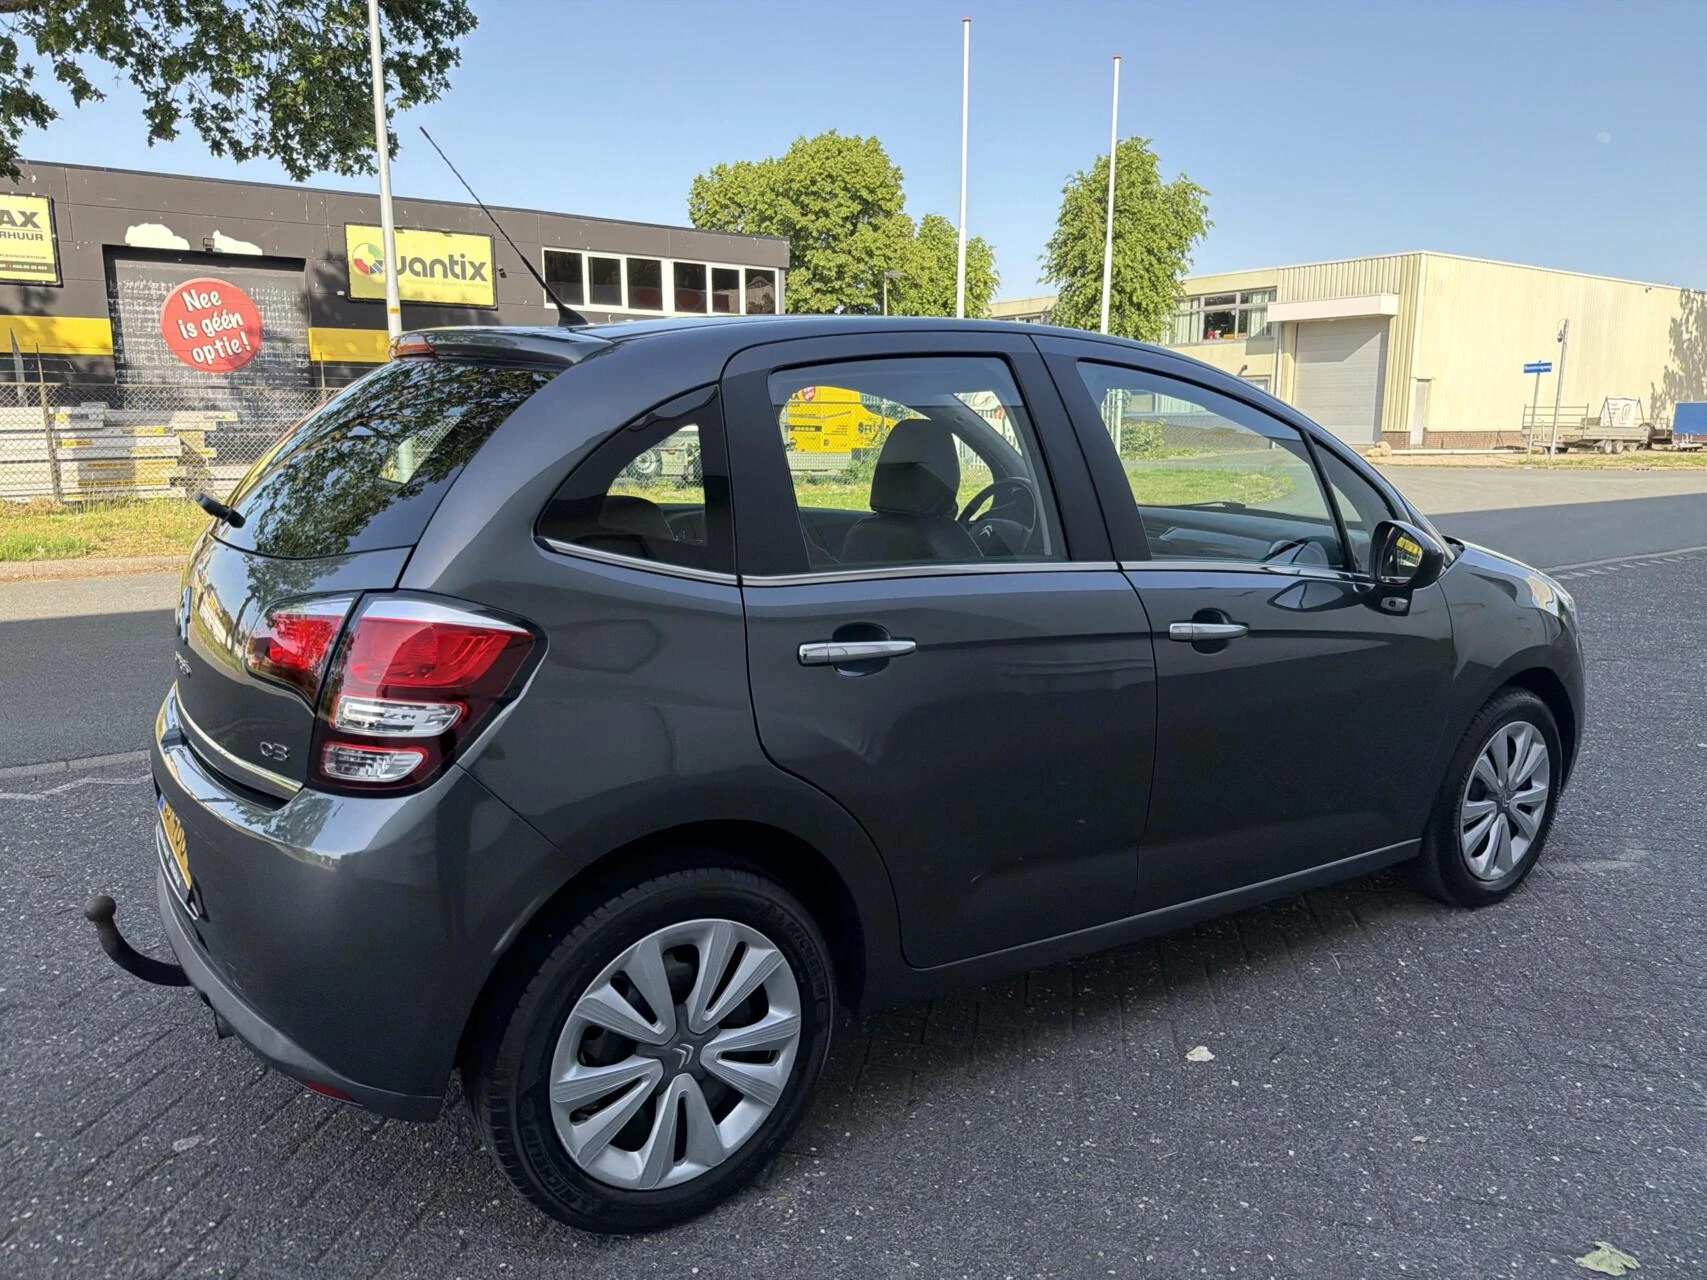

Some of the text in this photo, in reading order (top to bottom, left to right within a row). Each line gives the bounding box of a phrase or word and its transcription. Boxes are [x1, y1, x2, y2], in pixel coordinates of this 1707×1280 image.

[181, 288, 222, 312] Nee
[177, 309, 244, 340] is géén
[192, 331, 251, 365] optie!
[260, 741, 290, 762] C3
